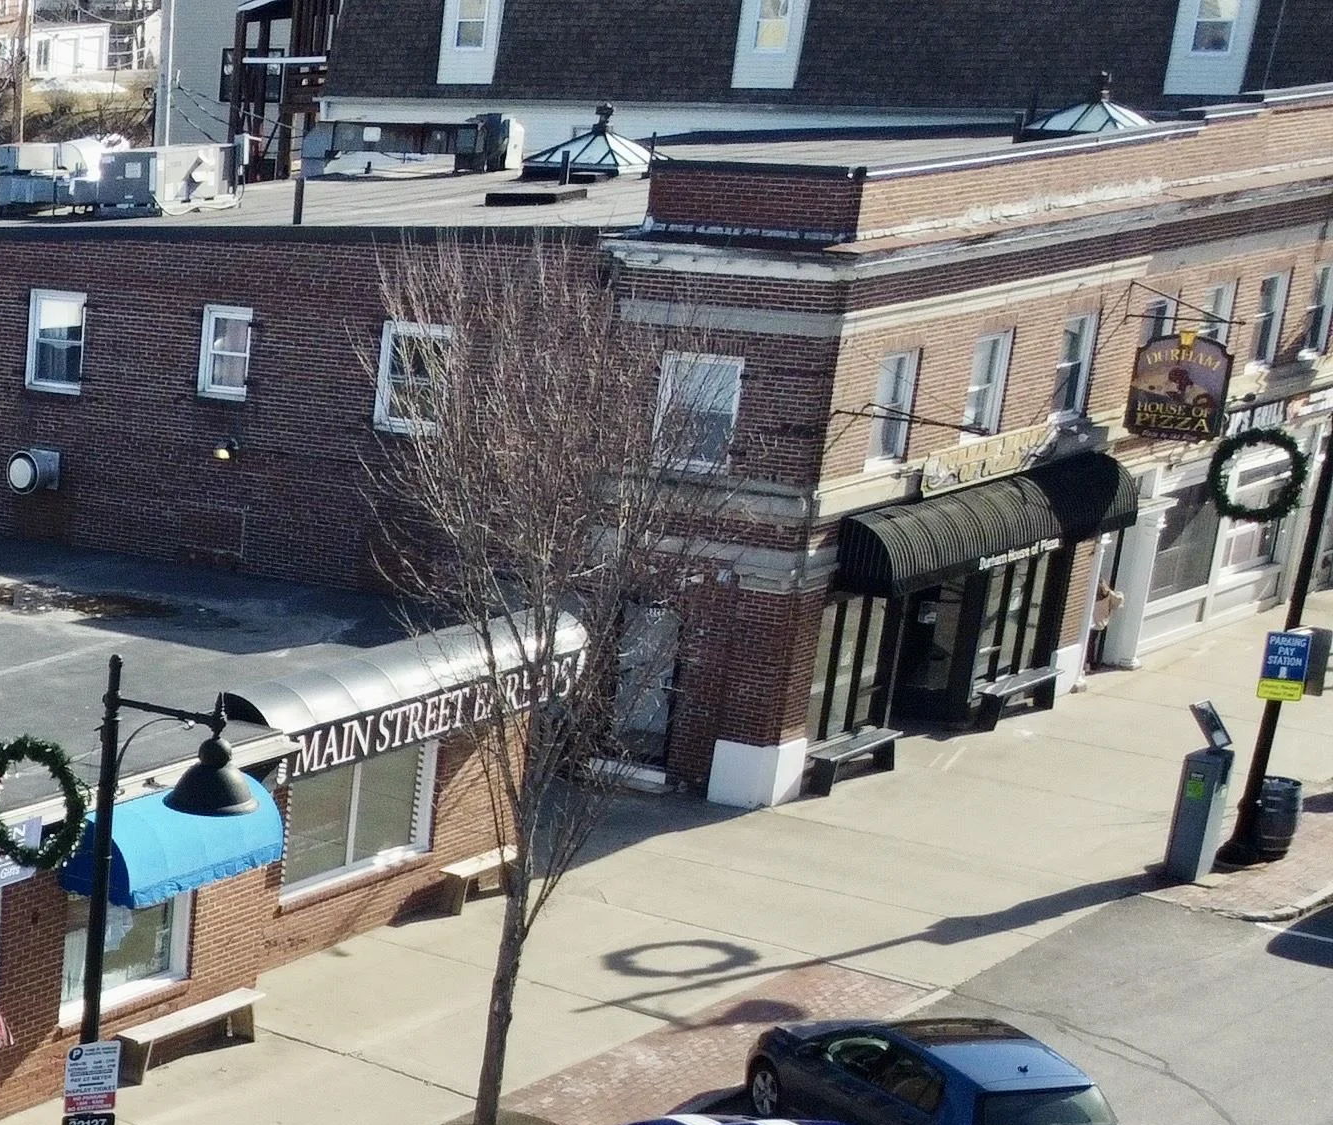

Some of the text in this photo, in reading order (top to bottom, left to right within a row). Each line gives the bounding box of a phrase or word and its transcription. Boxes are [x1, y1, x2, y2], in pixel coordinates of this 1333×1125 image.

[1137, 401, 1210, 418] HOUSE OF
[1134, 413, 1210, 433] PIZZA
[1269, 636, 1307, 648] PARKING
[1277, 647, 1296, 656] PAY
[1267, 655, 1303, 667] STATION
[291, 714, 375, 777] MAIN
[375, 685, 469, 753] STREET
[0, 866, 21, 880] Gifts
